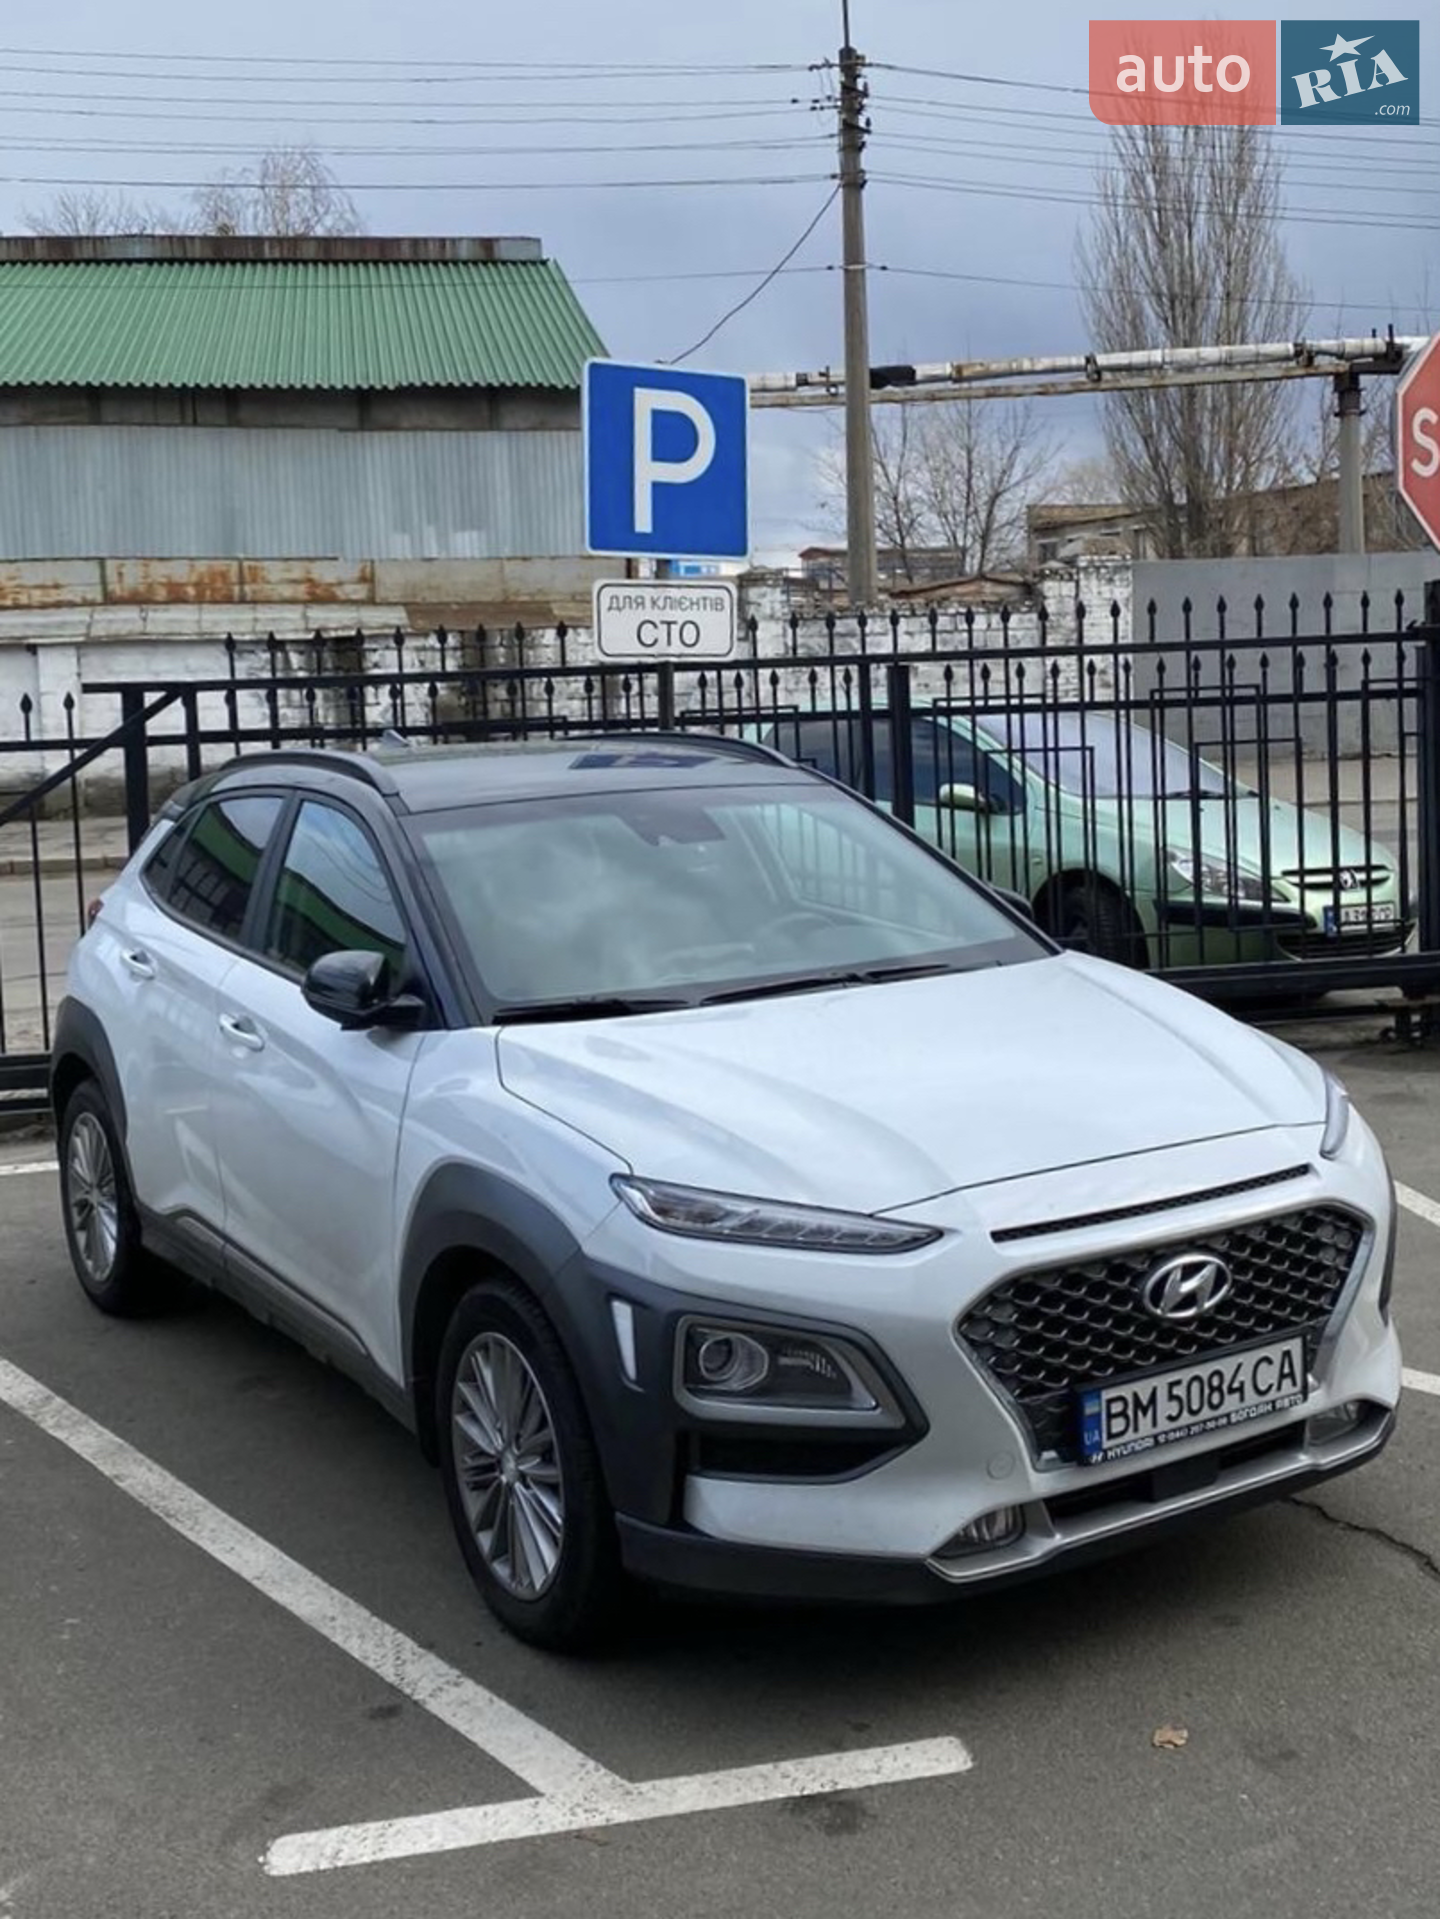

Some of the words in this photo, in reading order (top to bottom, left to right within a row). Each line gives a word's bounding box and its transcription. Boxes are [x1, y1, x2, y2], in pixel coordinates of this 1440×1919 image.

[633, 387, 716, 534] P
[607, 594, 646, 614] ДЛЯ
[650, 595, 725, 612] КЛІЄНТІВ
[636, 618, 701, 648] СТО
[1104, 1385, 1158, 1442] BM
[1165, 1361, 1246, 1422] 5084
[1251, 1348, 1298, 1397] CA
[1084, 1430, 1101, 1446] UA
[1106, 1435, 1155, 1460] HYUNDAI
